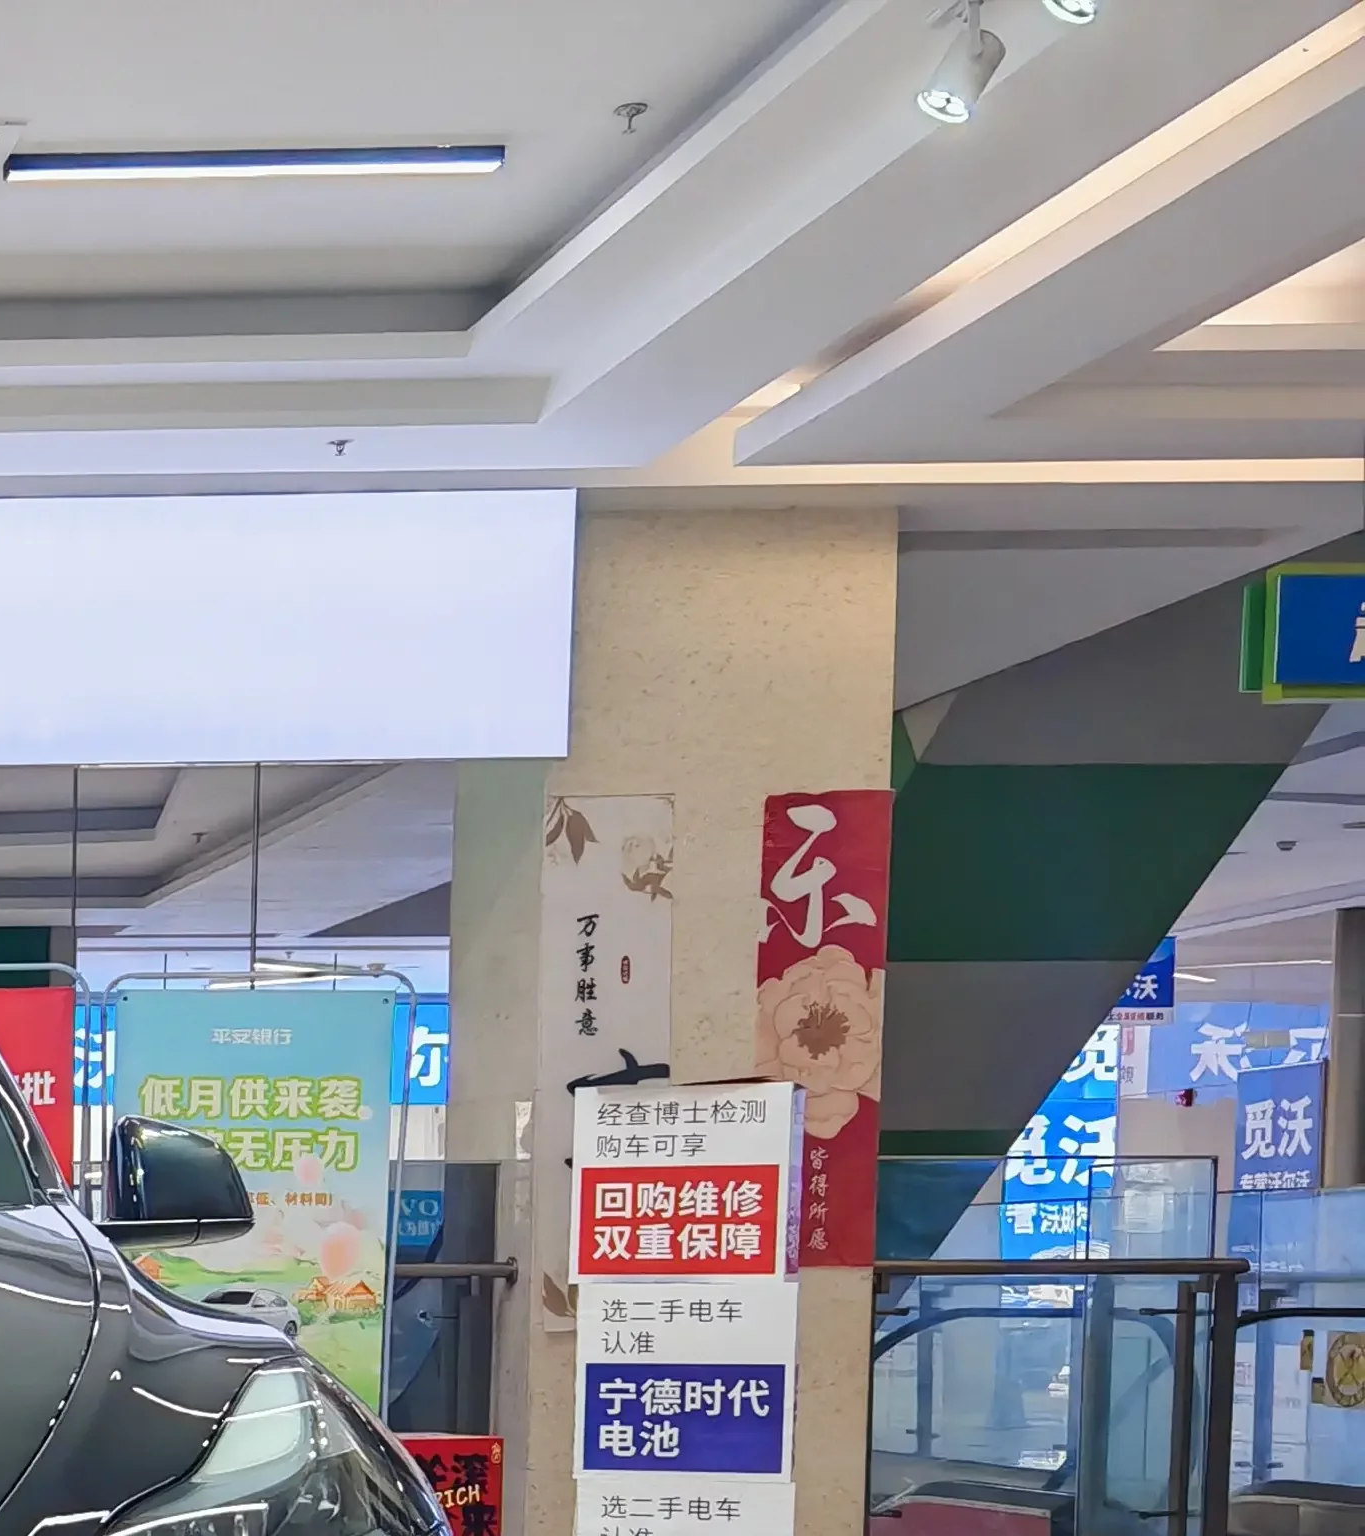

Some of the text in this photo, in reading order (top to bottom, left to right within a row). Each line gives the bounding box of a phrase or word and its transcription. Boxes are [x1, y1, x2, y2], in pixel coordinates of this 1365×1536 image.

[574, 913, 601, 1038] 万事胜意
[1119, 974, 1159, 1001] 沃
[211, 1028, 293, 1046] 平安银行
[13, 1070, 56, 1106] 批
[140, 1076, 359, 1119] 低月供来袭
[595, 1099, 767, 1128] 经查博士检测
[1241, 1095, 1314, 1161] 觅沃
[594, 1132, 707, 1159] 购车可享
[593, 1180, 764, 1220] 回购维修
[808, 1146, 830, 1251] 皆得所愿
[592, 1222, 763, 1261] 双重保障
[600, 1298, 744, 1324] 选二手电车
[600, 1330, 656, 1355] 认准
[598, 1377, 771, 1418] 宁德时代
[598, 1420, 681, 1458] 电池
[600, 1496, 742, 1522] 选二手电车
